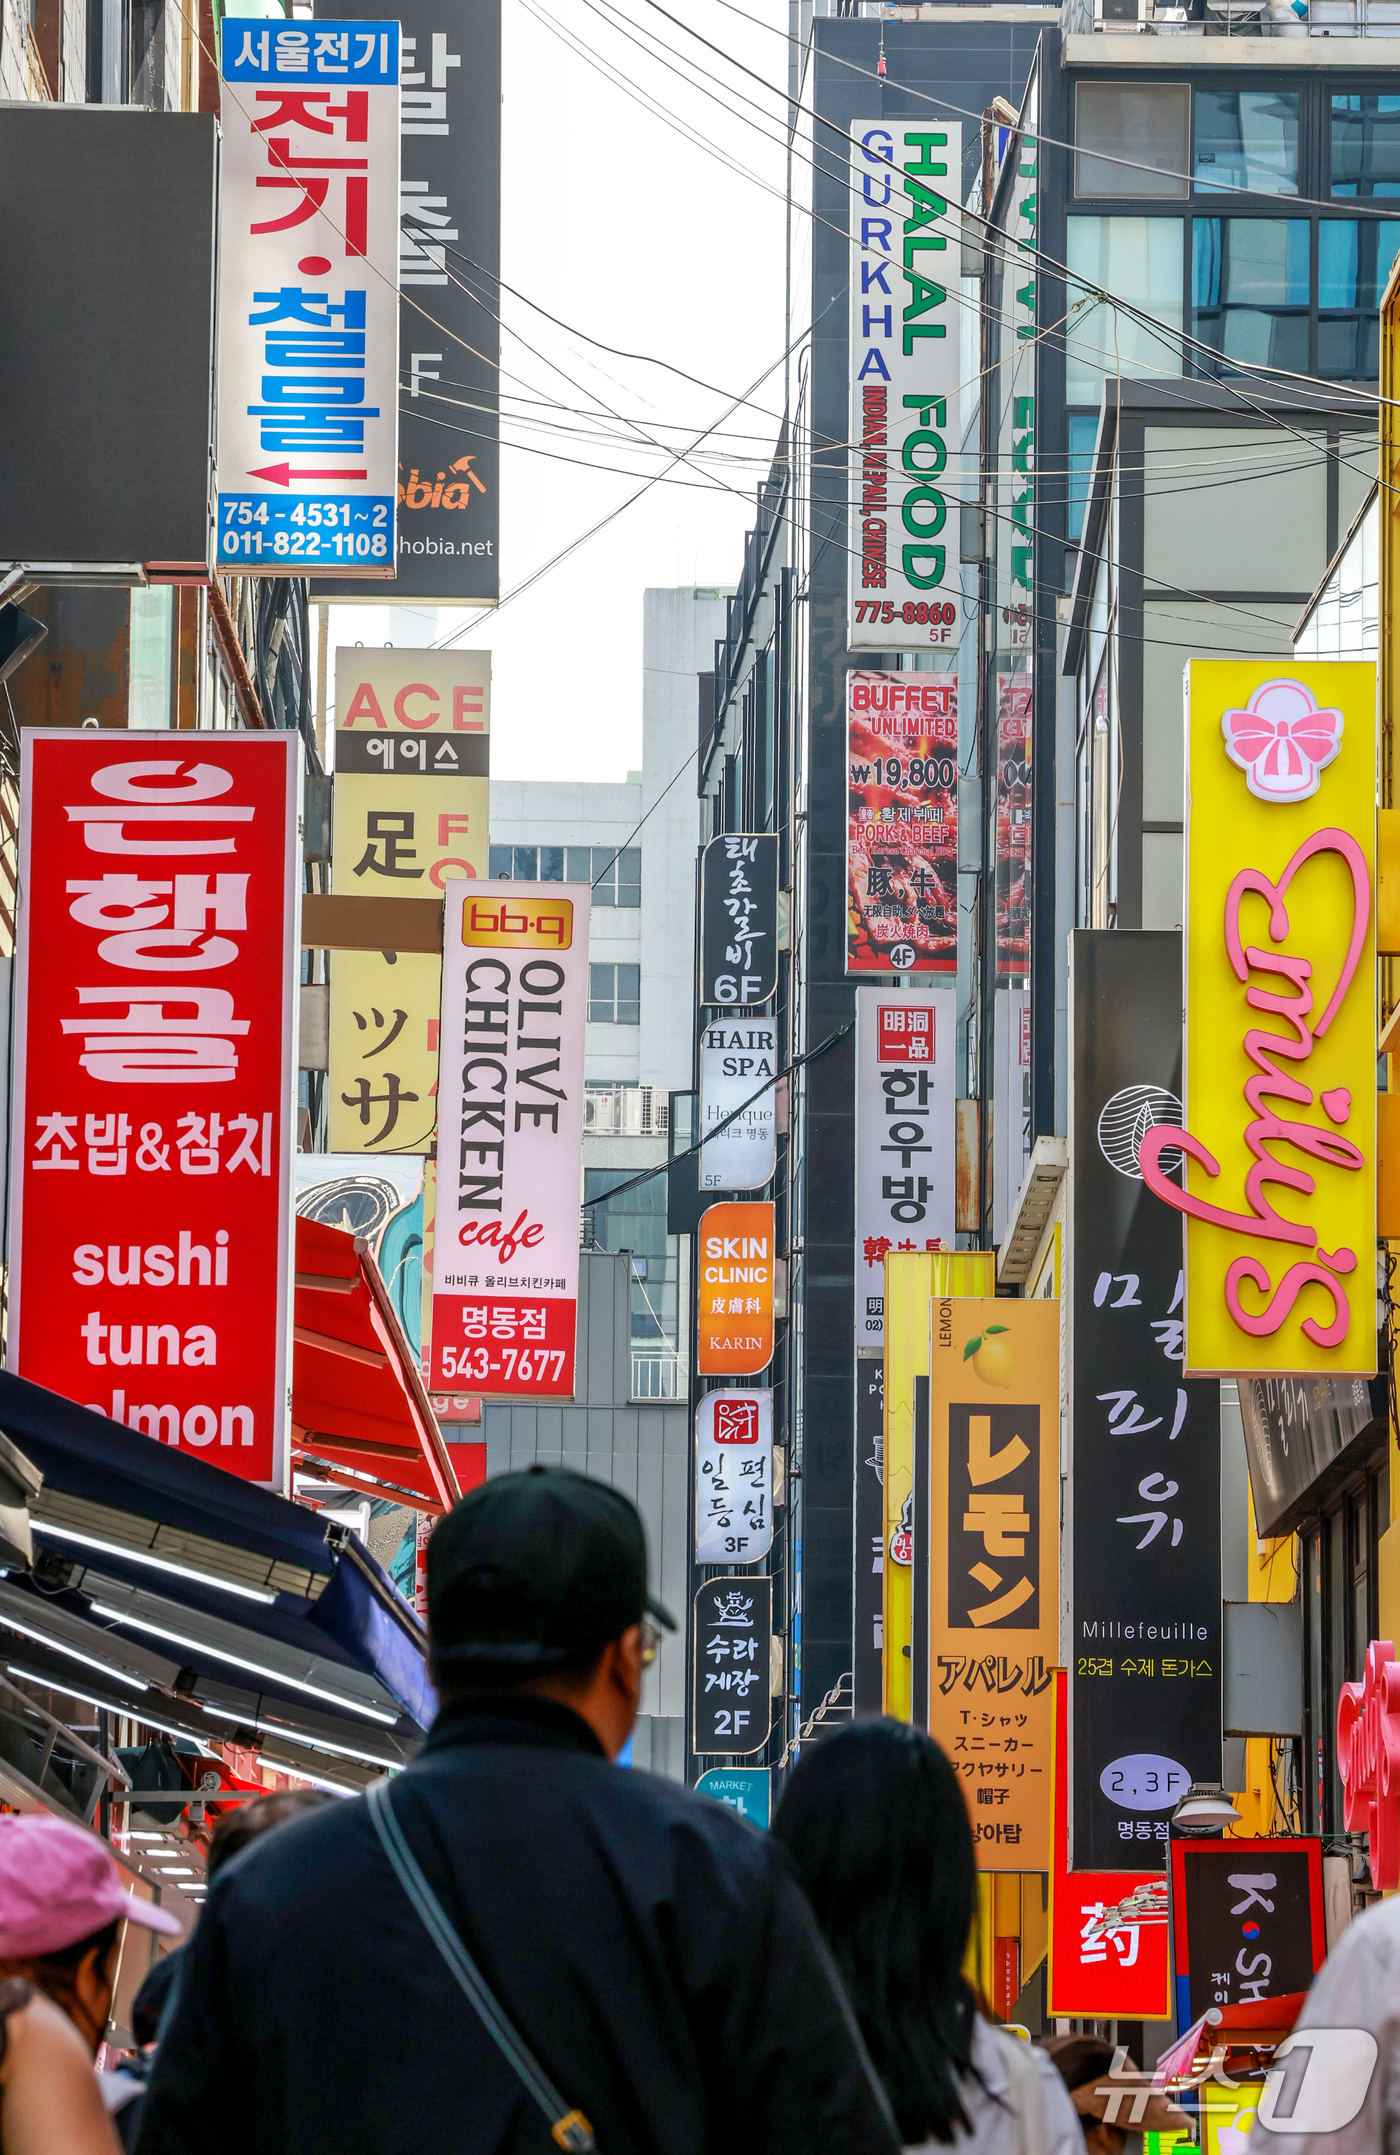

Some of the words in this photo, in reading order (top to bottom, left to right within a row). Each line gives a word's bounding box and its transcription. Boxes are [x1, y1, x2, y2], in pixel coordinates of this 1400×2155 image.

[234, 30, 389, 74] 서울전기
[857, 129, 893, 381] GURKHA
[903, 132, 948, 357] HALAL
[902, 394, 947, 590] FOOD
[223, 530, 388, 557] 011-822-1108
[398, 535, 494, 556] hobia.net
[855, 601, 956, 625] 775-8860
[929, 628, 952, 643] 5F
[342, 683, 484, 731] ACE
[853, 685, 956, 712] BUFFET
[871, 716, 955, 736] UNLIMITED
[366, 738, 459, 771] 에이스
[880, 806, 944, 823] 황제뷔페
[856, 824, 896, 842] PORK
[900, 828, 908, 842] &
[912, 824, 949, 843] BEEF
[60, 760, 256, 1084] 은행골
[892, 947, 912, 966] 4F
[714, 974, 762, 1003] 6F
[514, 960, 568, 1134] OLIVE
[706, 1030, 775, 1050] HAIR
[722, 1058, 774, 1077] SPA
[458, 957, 511, 1213] CHICKEN
[880, 1069, 934, 1223] 한우방
[704, 1174, 722, 1187] 5F
[458, 1208, 545, 1264] cafe
[706, 1237, 768, 1259] SKIN
[72, 1229, 230, 1287] sushi
[444, 1274, 479, 1287] 비비큐
[484, 1275, 566, 1291] 올리브치킨카페
[704, 1266, 768, 1284] CLINIC
[710, 1297, 762, 1315] 皮膚科
[462, 1306, 547, 1341] 명동점
[939, 1297, 952, 1348] LEMON
[81, 1311, 217, 1367] tuna
[709, 1337, 763, 1350] KARIN
[442, 1346, 566, 1382] 543-7677
[82, 1389, 255, 1446] lmon
[963, 1415, 1036, 1628] レモン
[724, 1537, 749, 1553] 3F
[1082, 1621, 1209, 1641] Millefeuille
[706, 1634, 759, 1664] 수라
[937, 1655, 1052, 1697] アパレル
[1078, 1657, 1114, 1677] 25겹
[1120, 1658, 1155, 1678] 수제
[1161, 1658, 1213, 1678] 돈가스
[704, 1669, 760, 1697] 게장
[714, 1710, 750, 1735] 2F
[954, 1736, 1034, 1752] スニーカー
[709, 1781, 753, 1792] MARKET
[977, 1787, 1010, 1805] 帽子
[1117, 1820, 1170, 1840] 명동점
